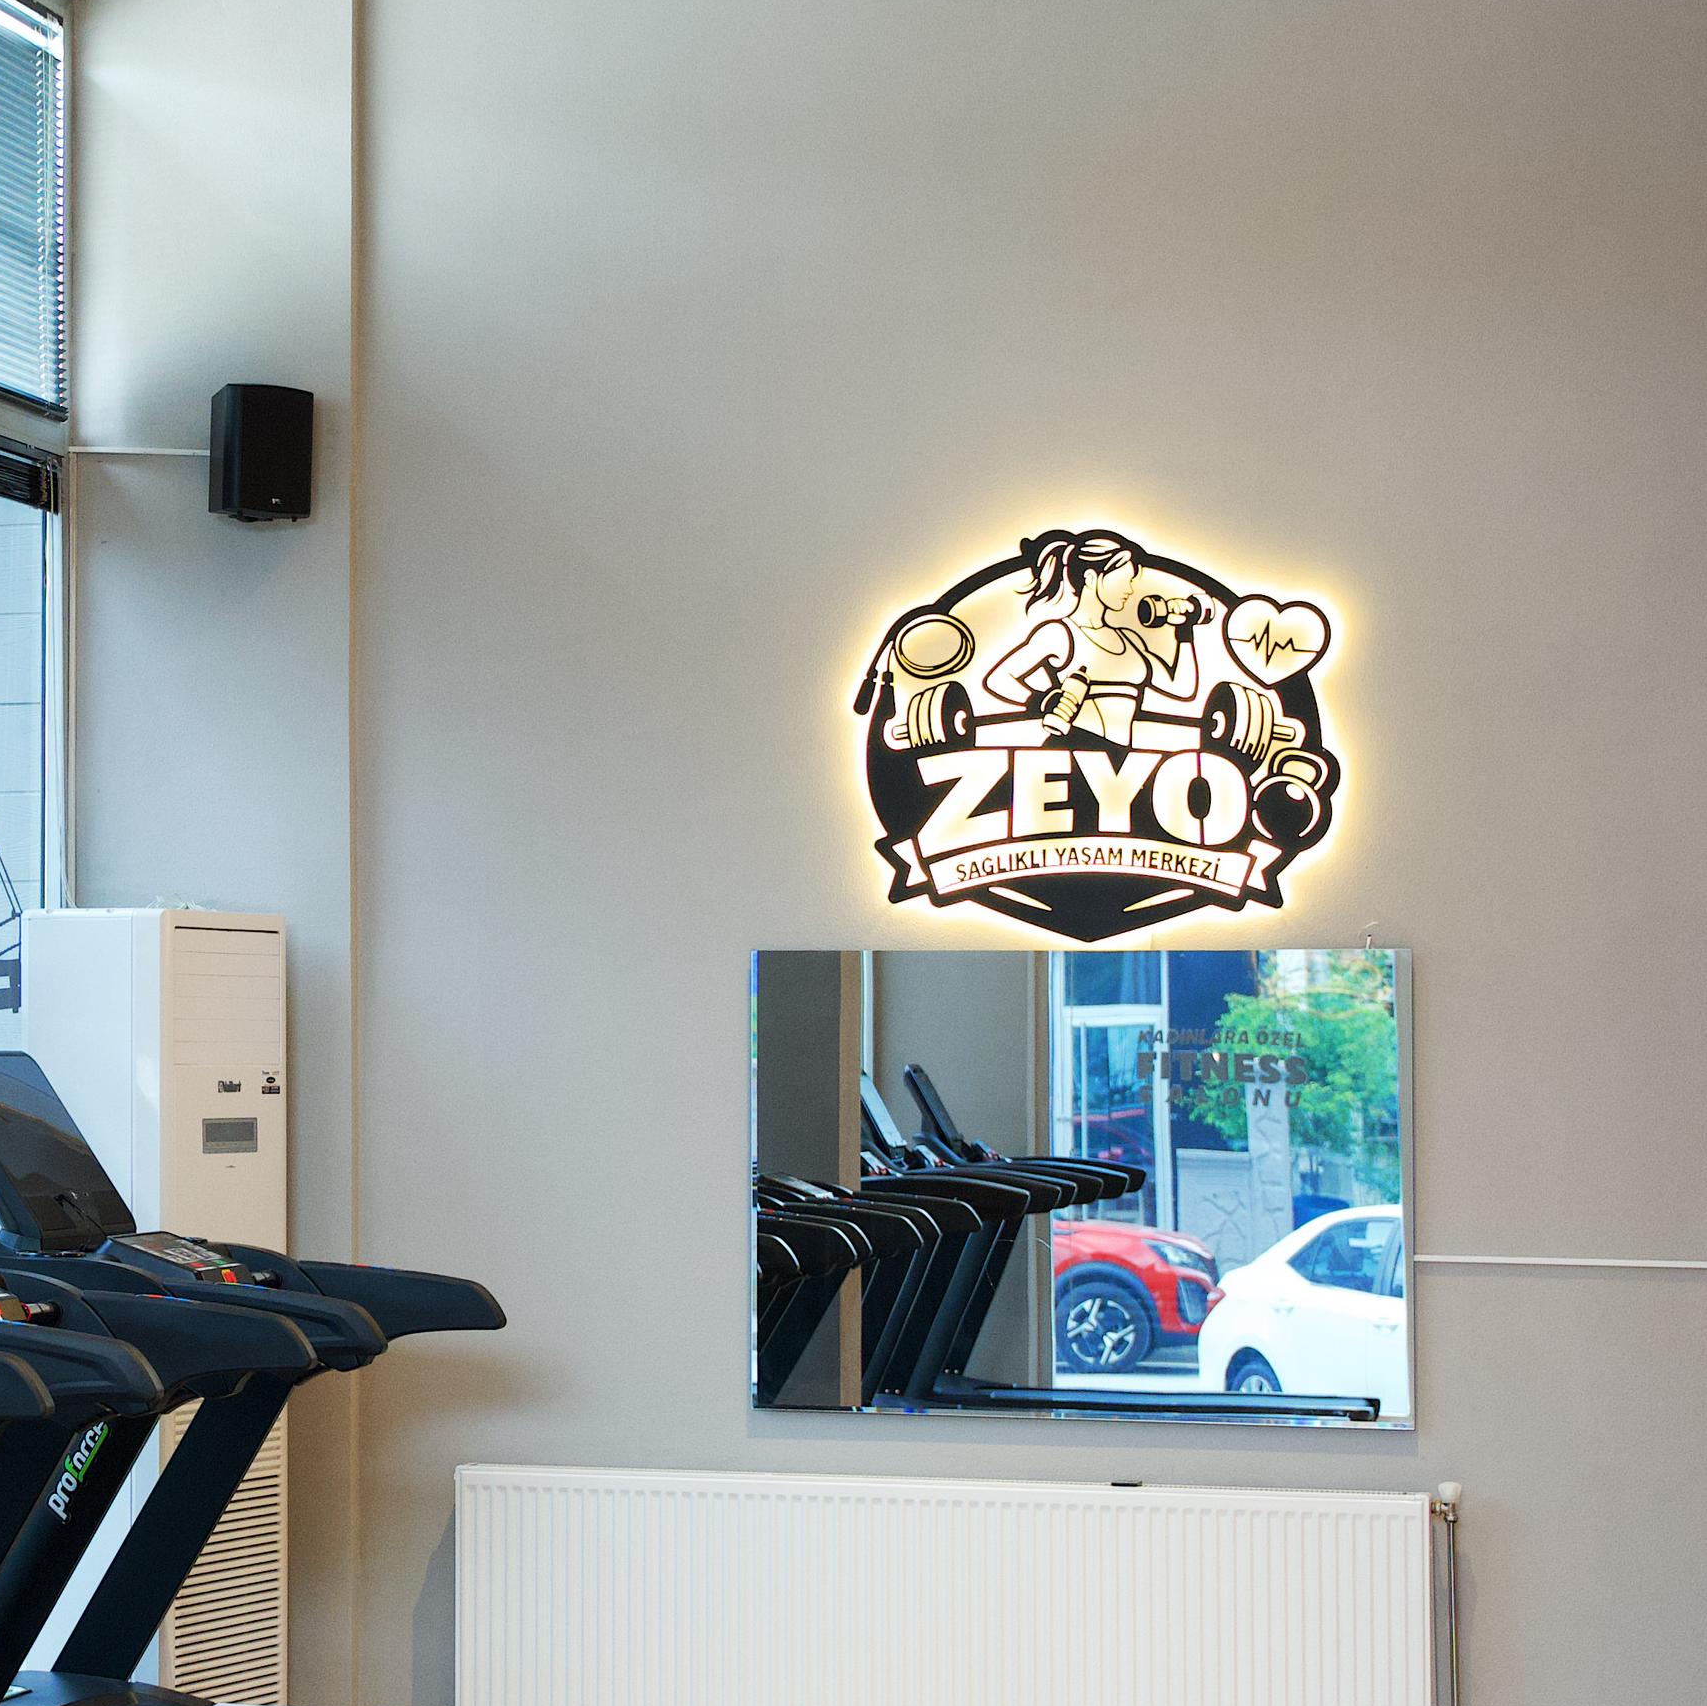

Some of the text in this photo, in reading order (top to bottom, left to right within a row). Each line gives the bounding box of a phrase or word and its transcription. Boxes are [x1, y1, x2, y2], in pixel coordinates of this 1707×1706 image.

[916, 748, 1249, 847] ZEYO
[1054, 846, 1123, 866] YAŞAM
[1130, 848, 1222, 882] MERKEZİ
[1137, 1025, 1306, 1048] KADINLARA ÖZEL
[1137, 1051, 1309, 1085] FITNESS
